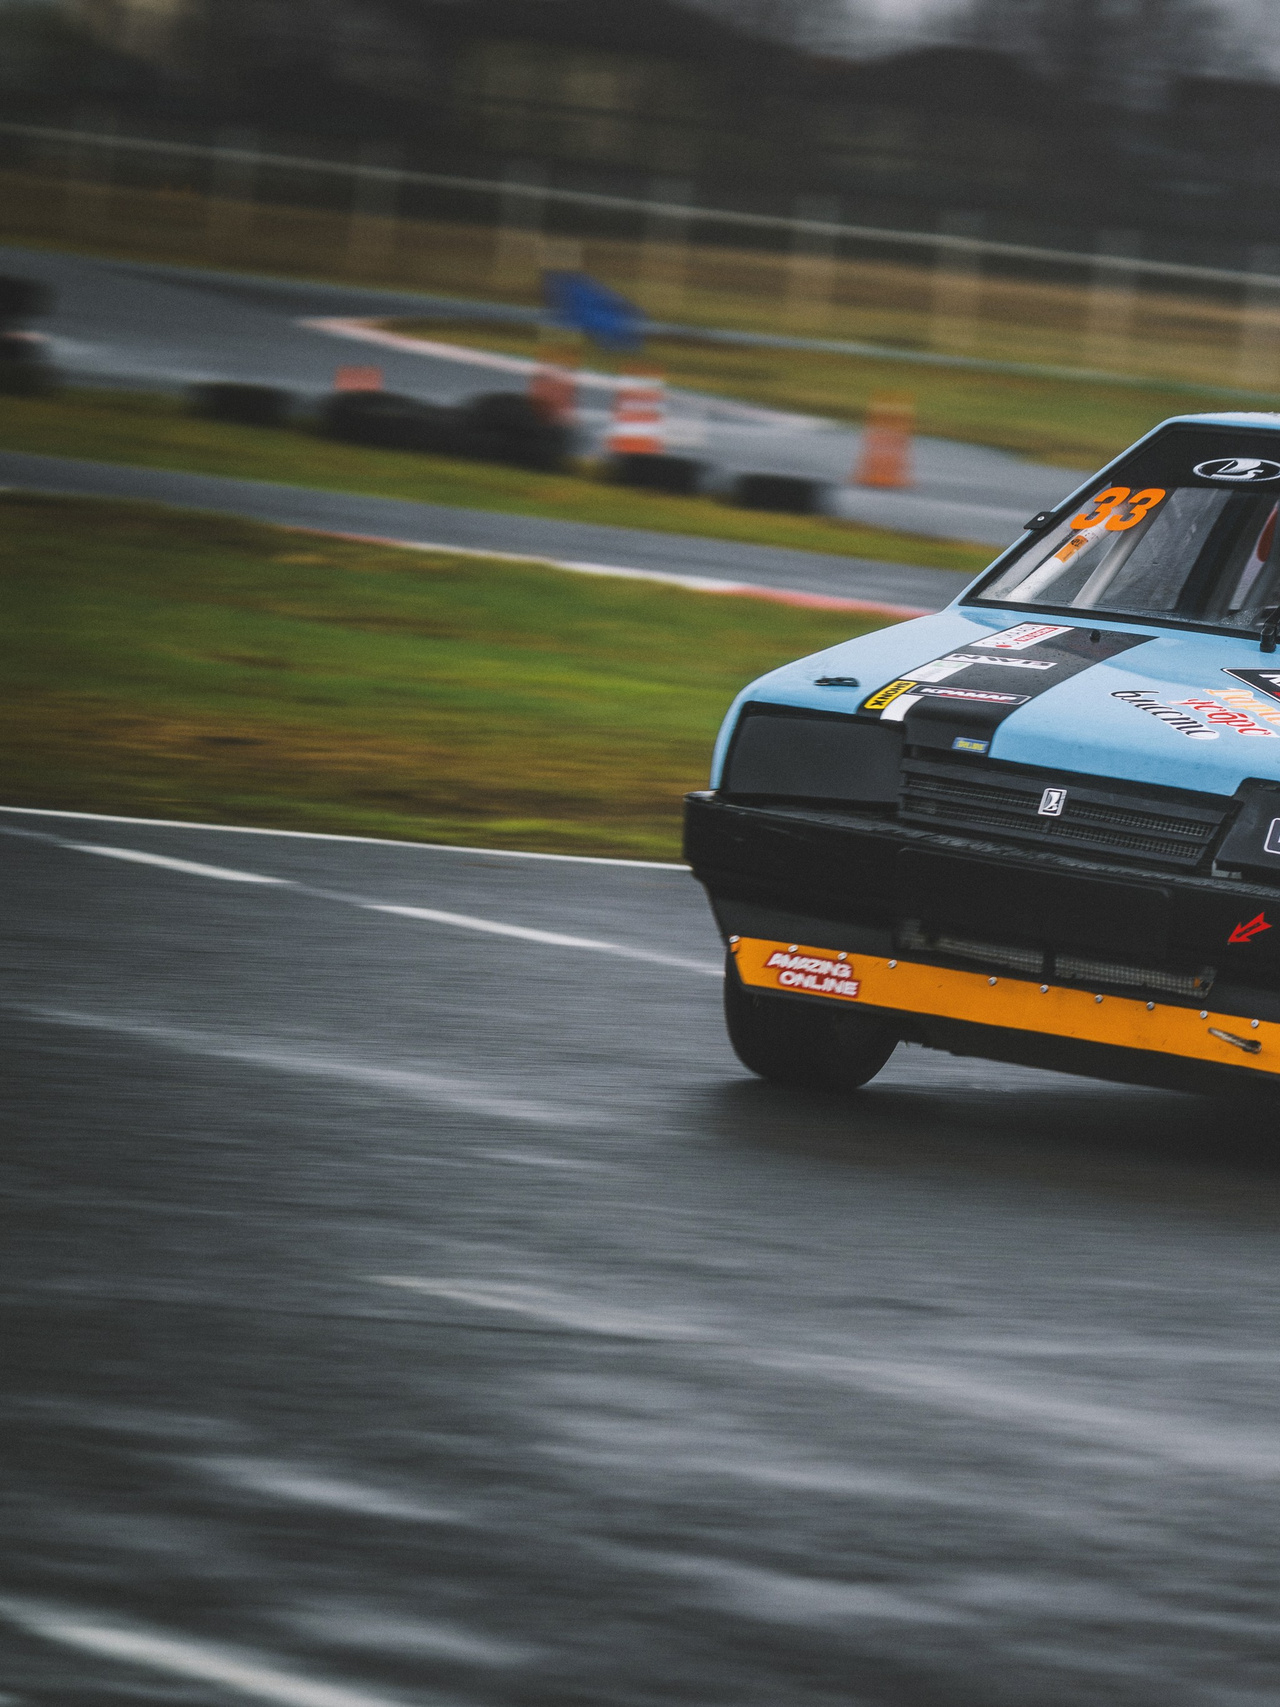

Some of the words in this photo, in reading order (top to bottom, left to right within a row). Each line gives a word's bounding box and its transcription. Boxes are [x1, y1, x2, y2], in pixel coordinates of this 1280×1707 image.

[1070, 487, 1166, 531] 33
[766, 952, 852, 979] AMAZING
[779, 970, 860, 996] ONLINE
